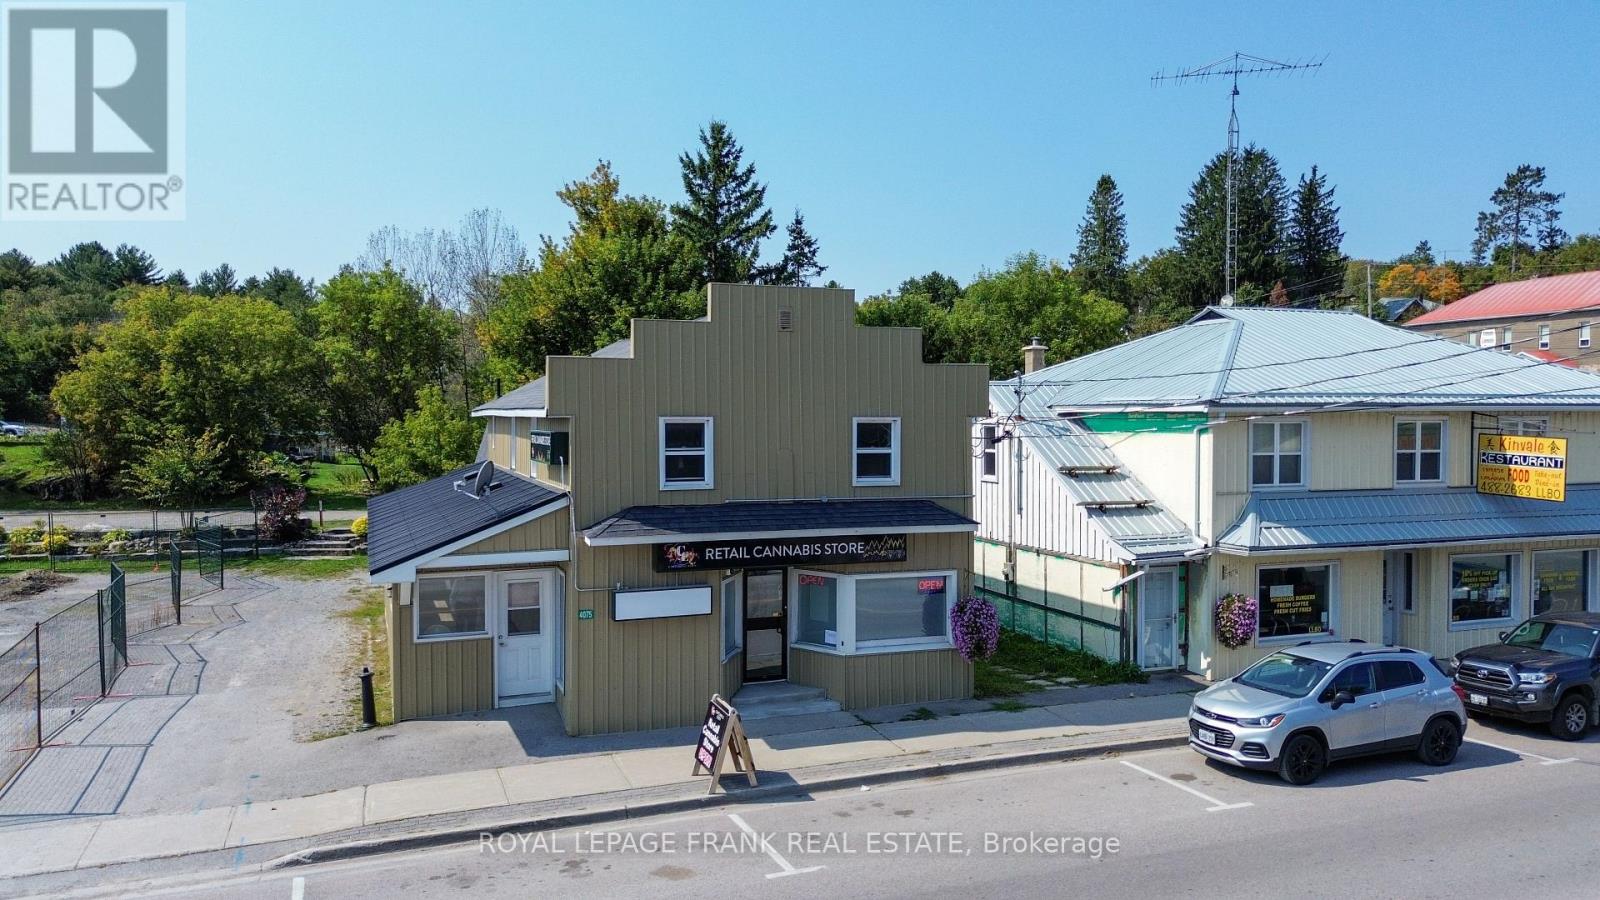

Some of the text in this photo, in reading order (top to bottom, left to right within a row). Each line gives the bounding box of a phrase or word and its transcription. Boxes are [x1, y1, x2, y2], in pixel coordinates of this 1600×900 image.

[1499, 437, 1545, 453] Kinvale
[1480, 452, 1565, 468] RESTAURANT
[1508, 468, 1530, 482] FOOD
[1537, 488, 1561, 499] LLBO
[705, 547, 750, 560] RETAIL
[753, 544, 822, 558] CANNABIS
[825, 541, 865, 555] STORE
[800, 576, 825, 586] OPEN
[918, 580, 944, 590] OPEN
